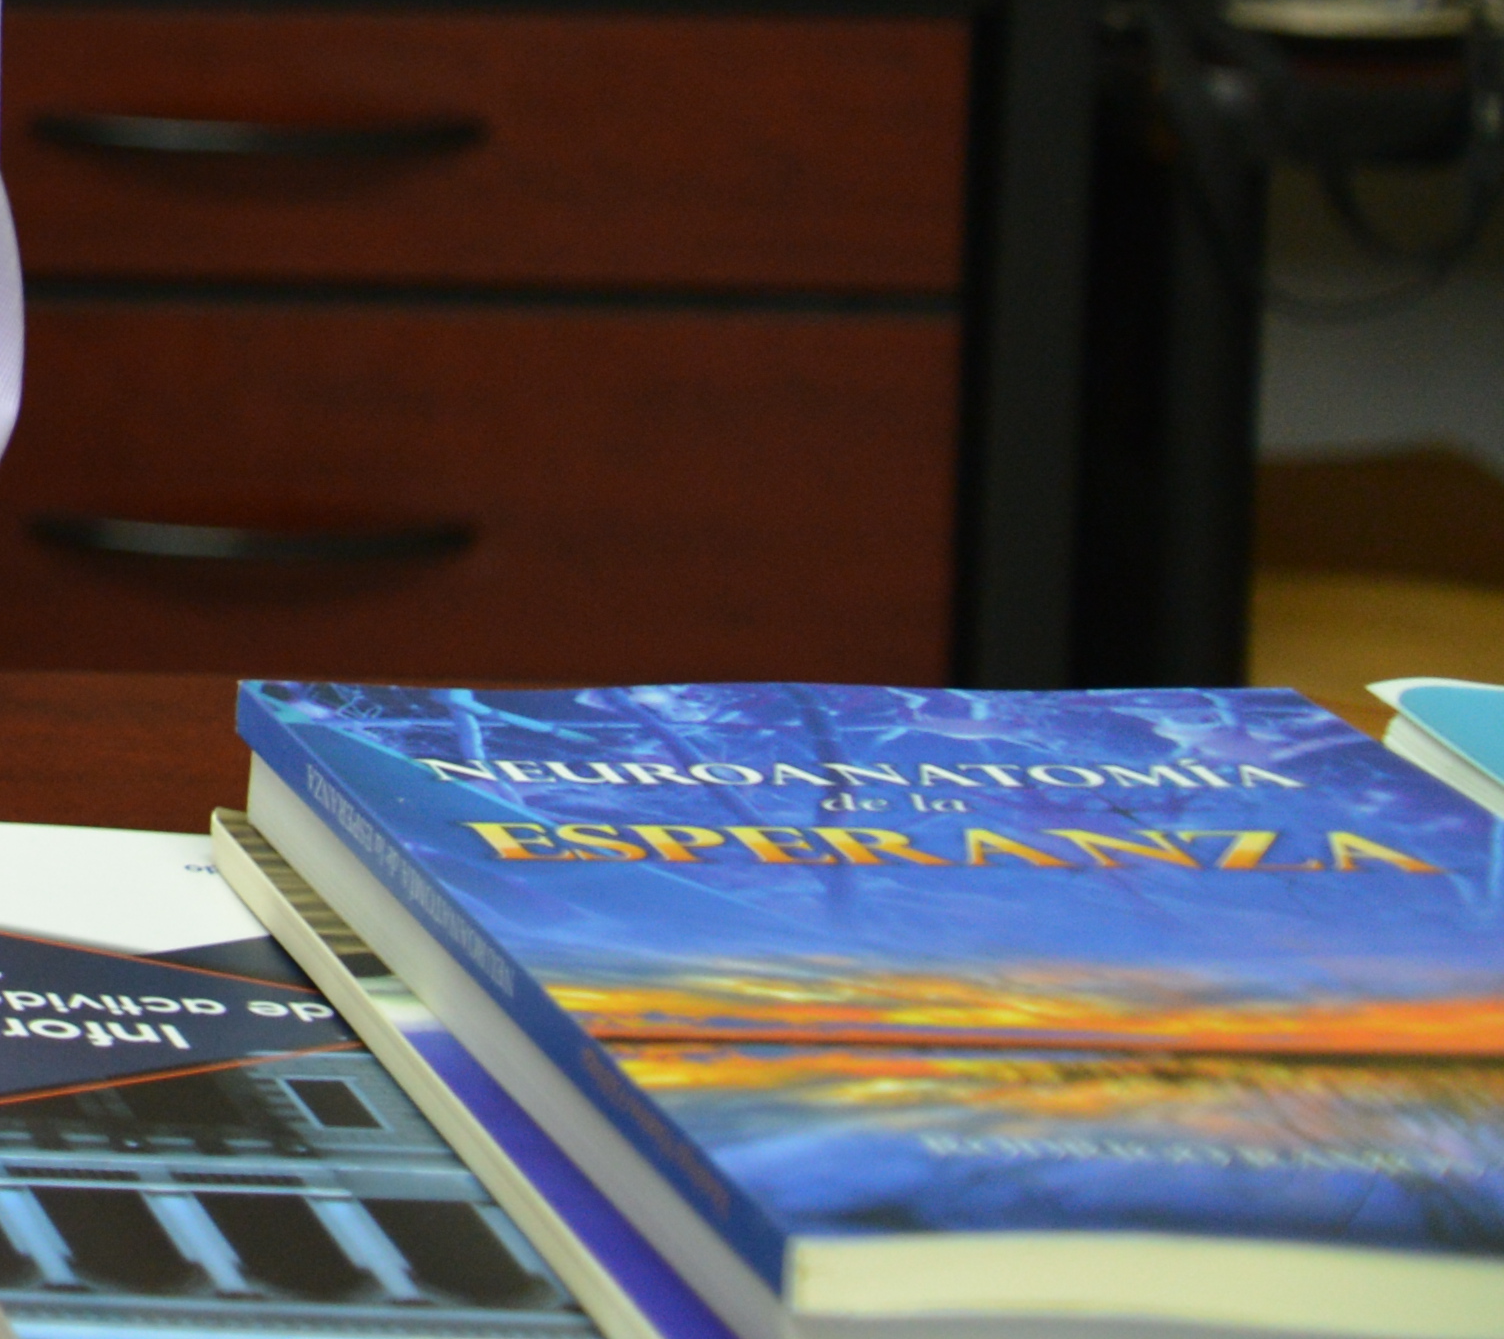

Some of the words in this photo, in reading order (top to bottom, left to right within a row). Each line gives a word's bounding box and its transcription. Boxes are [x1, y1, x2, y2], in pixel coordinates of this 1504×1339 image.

[413, 757, 1307, 790] NEUROANATOMÍA
[820, 792, 890, 813] de
[910, 791, 967, 814] la
[462, 821, 1446, 875] ESPERANZA
[247, 1001, 335, 1023] de
